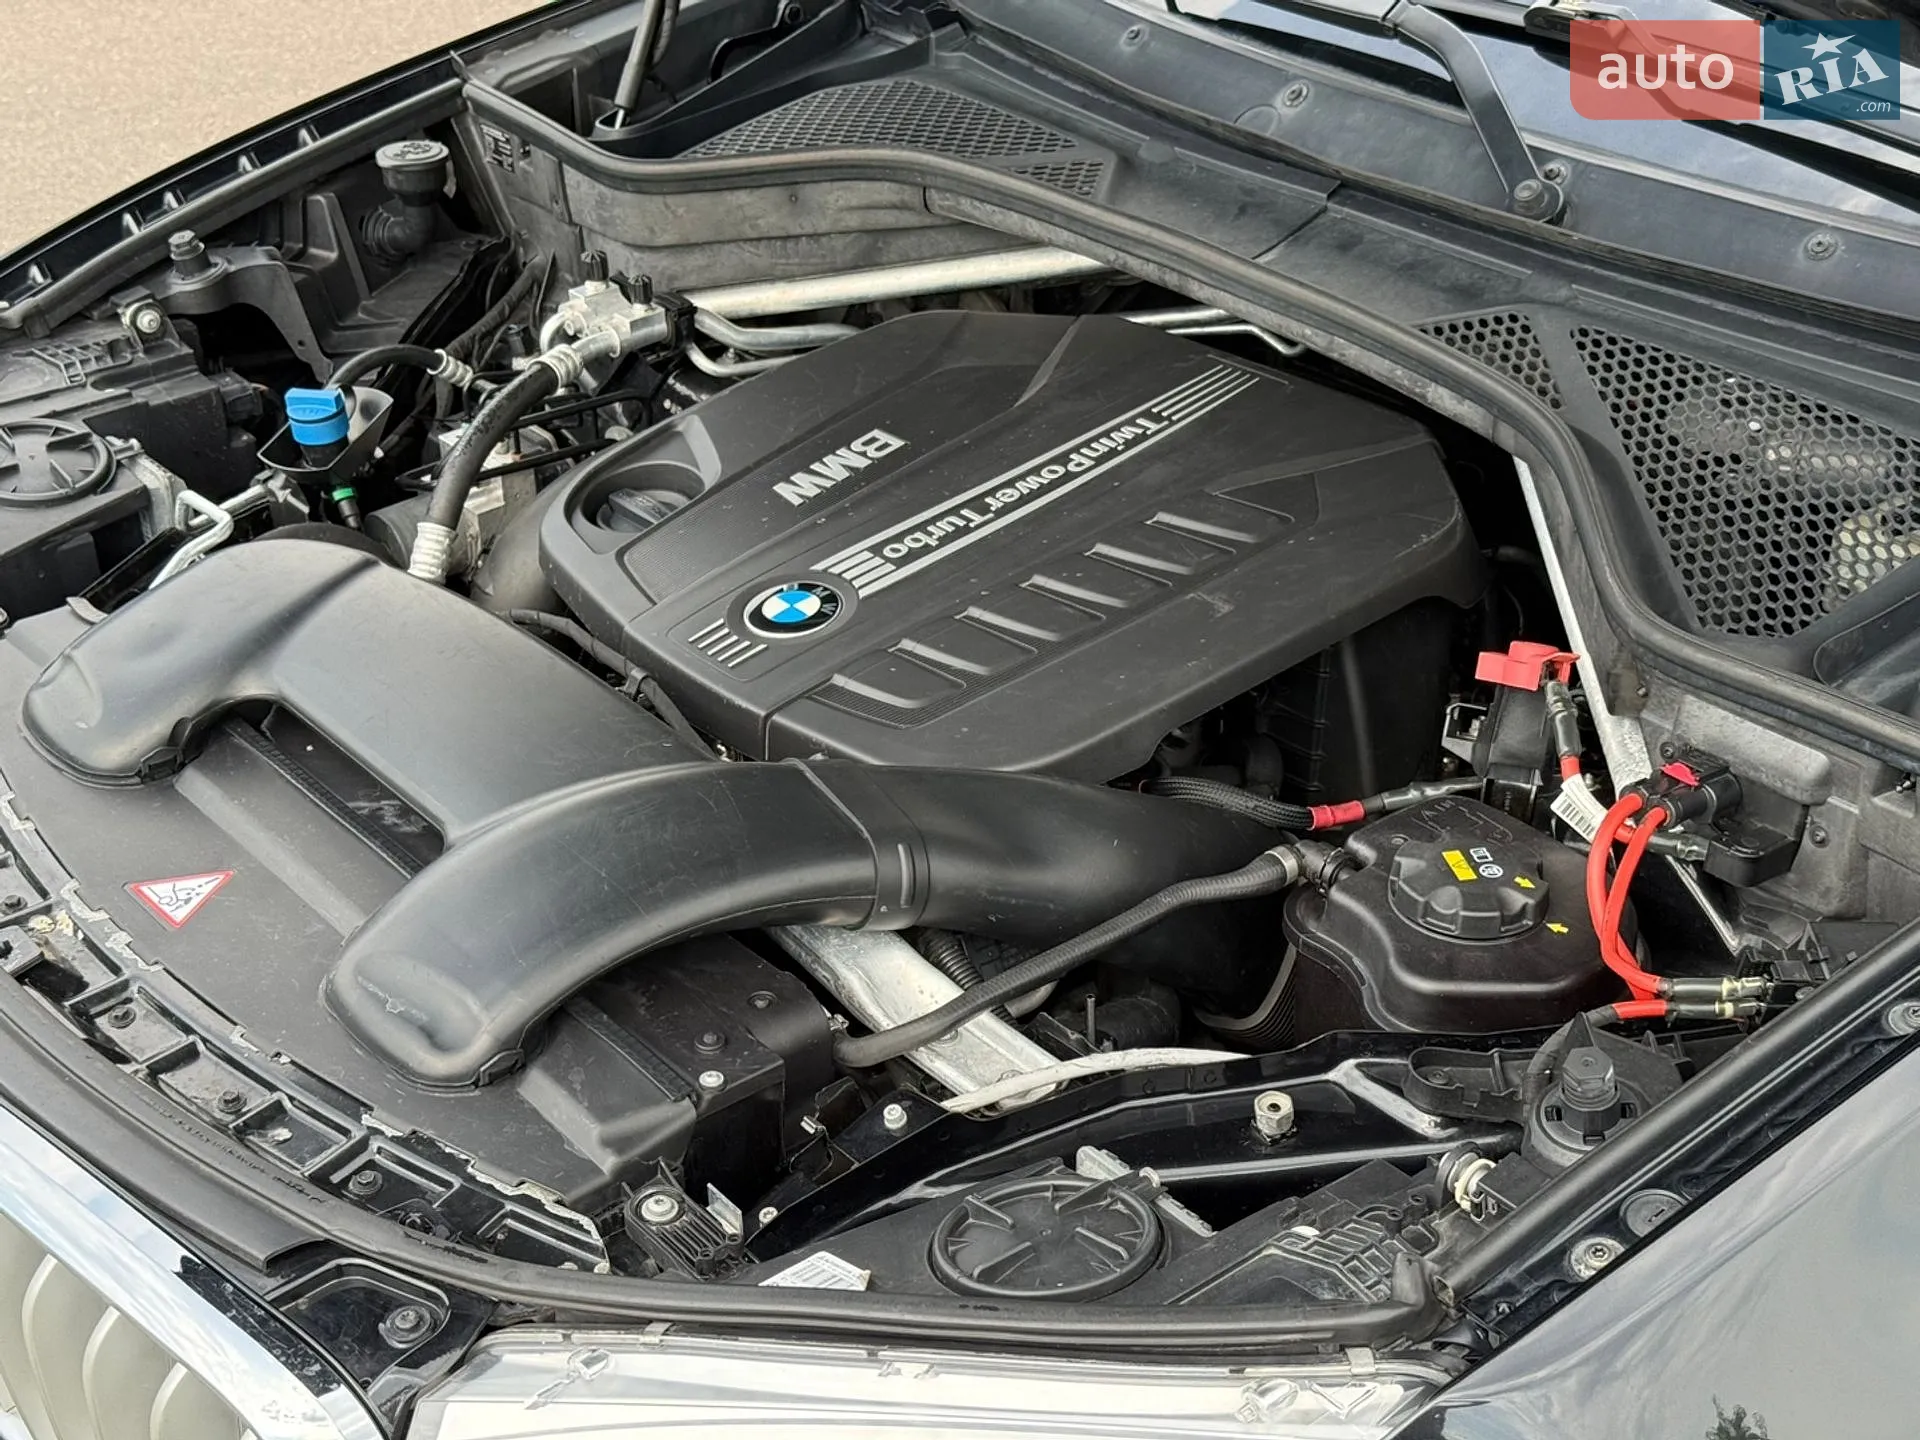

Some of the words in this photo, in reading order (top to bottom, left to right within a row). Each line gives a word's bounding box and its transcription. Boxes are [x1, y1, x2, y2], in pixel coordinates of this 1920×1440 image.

[772, 428, 906, 507] BMW
[984, 417, 1169, 511] TwinPower
[882, 508, 995, 559] Turbo
